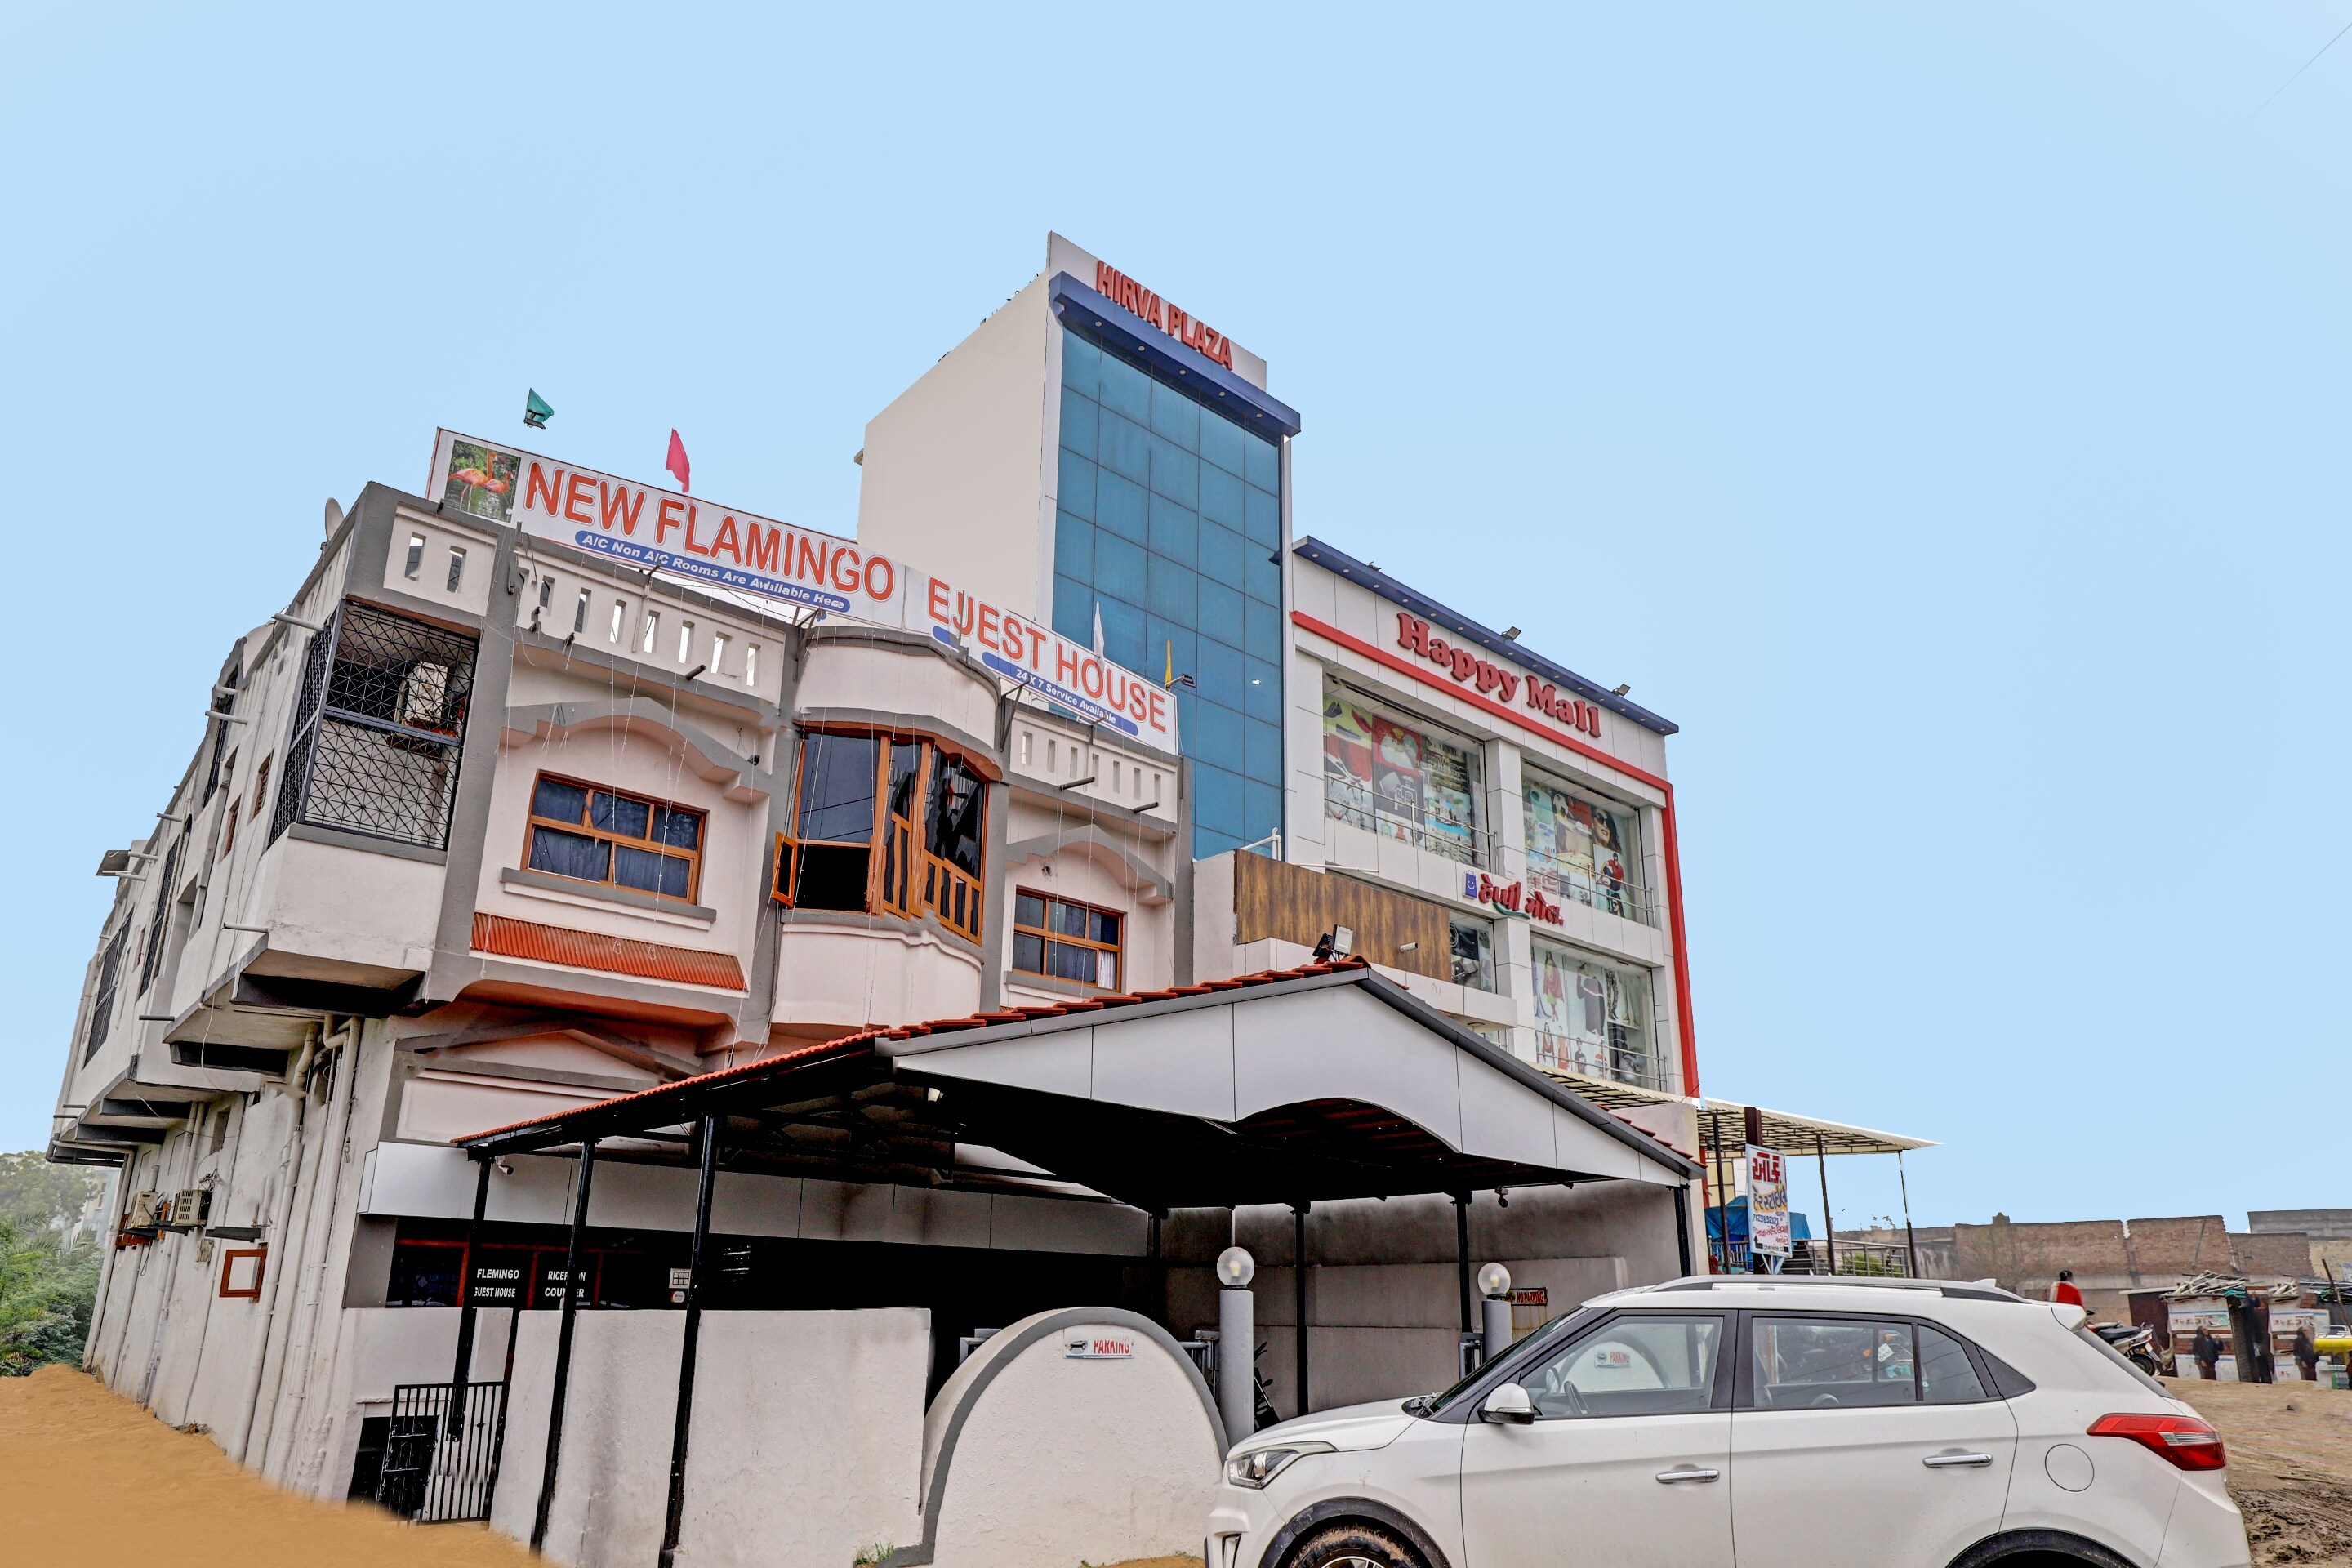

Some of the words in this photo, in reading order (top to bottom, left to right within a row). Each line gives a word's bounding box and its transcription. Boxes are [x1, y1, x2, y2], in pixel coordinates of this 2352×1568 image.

[1095, 260, 1163, 329] HIRVA
[1167, 303, 1233, 372] PLAZA
[523, 461, 645, 537] NEW
[654, 497, 895, 601] FLAMINGO
[582, 535, 608, 549] A/C
[612, 541, 641, 558] Non
[644, 551, 669, 564] A/C
[672, 557, 719, 578] Rooms
[722, 571, 746, 585] Are
[1016, 669, 1027, 681] 24
[1038, 679, 1045, 688] 7
[1046, 683, 1078, 706] Service
[1080, 700, 1116, 724] Available
[1057, 642, 1166, 734] HOUSE
[1397, 612, 1521, 702] Happy
[1525, 675, 1602, 737] Mall
[474, 1286, 494, 1297] GUEST
[494, 1287, 516, 1298] HOUSE
[476, 1268, 519, 1279] FLEMINGO
[1094, 1339, 1130, 1354] PARKING
